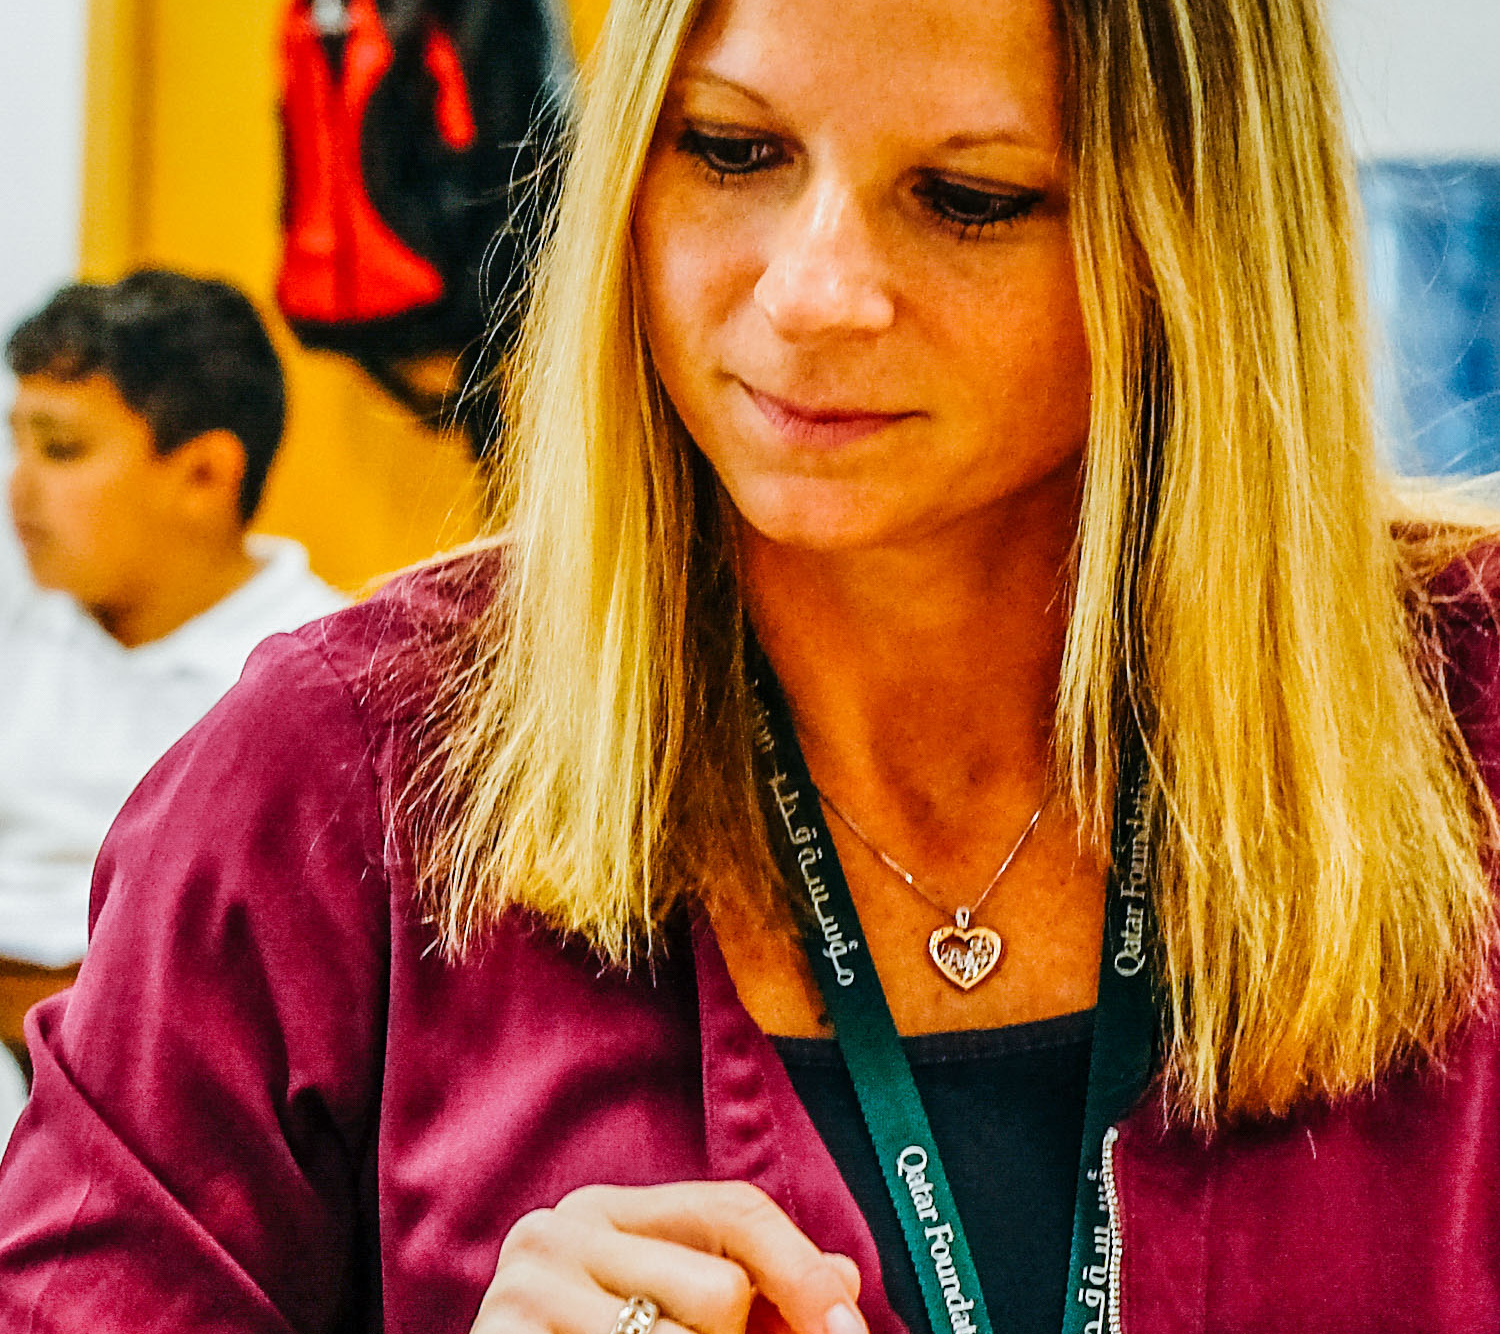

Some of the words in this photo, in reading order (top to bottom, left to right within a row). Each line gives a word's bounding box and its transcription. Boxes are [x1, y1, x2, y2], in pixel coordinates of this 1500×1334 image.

[797, 845, 858, 987] مؤسسة
[1114, 902, 1146, 977] Qatar
[897, 1144, 939, 1223] Qatar
